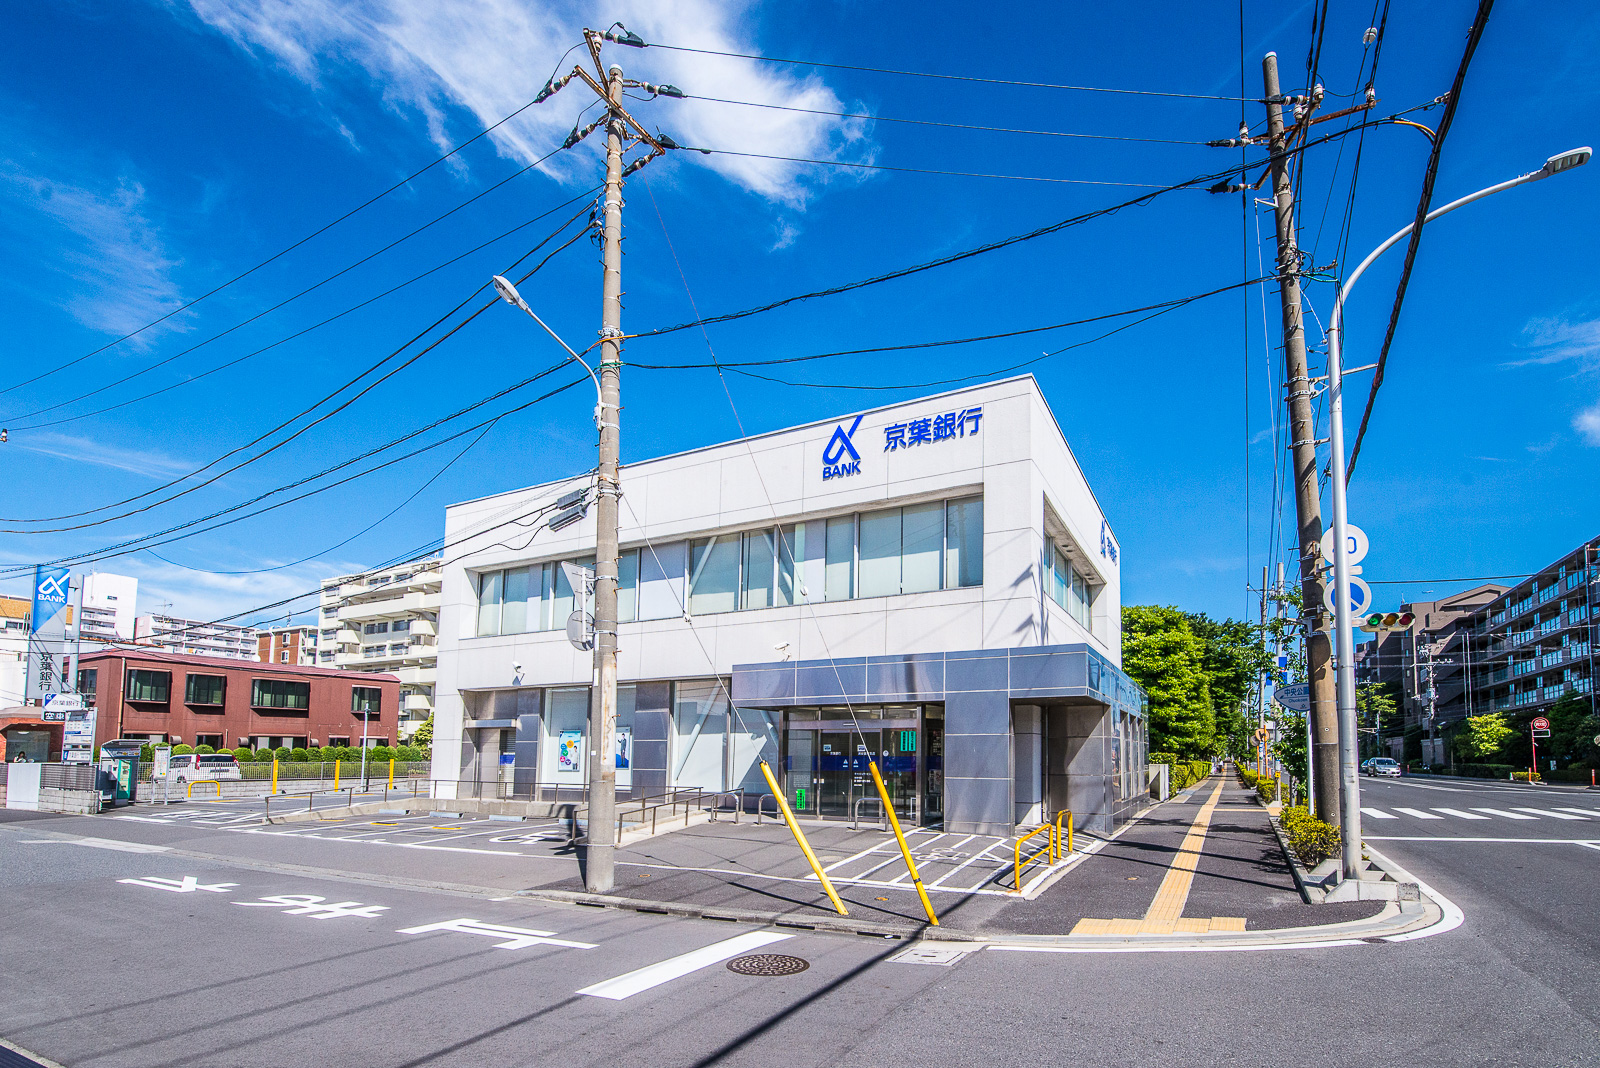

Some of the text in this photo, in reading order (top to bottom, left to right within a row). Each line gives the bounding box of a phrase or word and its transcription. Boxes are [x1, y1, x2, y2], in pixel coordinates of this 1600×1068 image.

[883, 407, 982, 452] 京葉銀行
[822, 460, 861, 480] BANK
[38, 594, 65, 603] BANK
[39, 653, 53, 691] 京葉銀行
